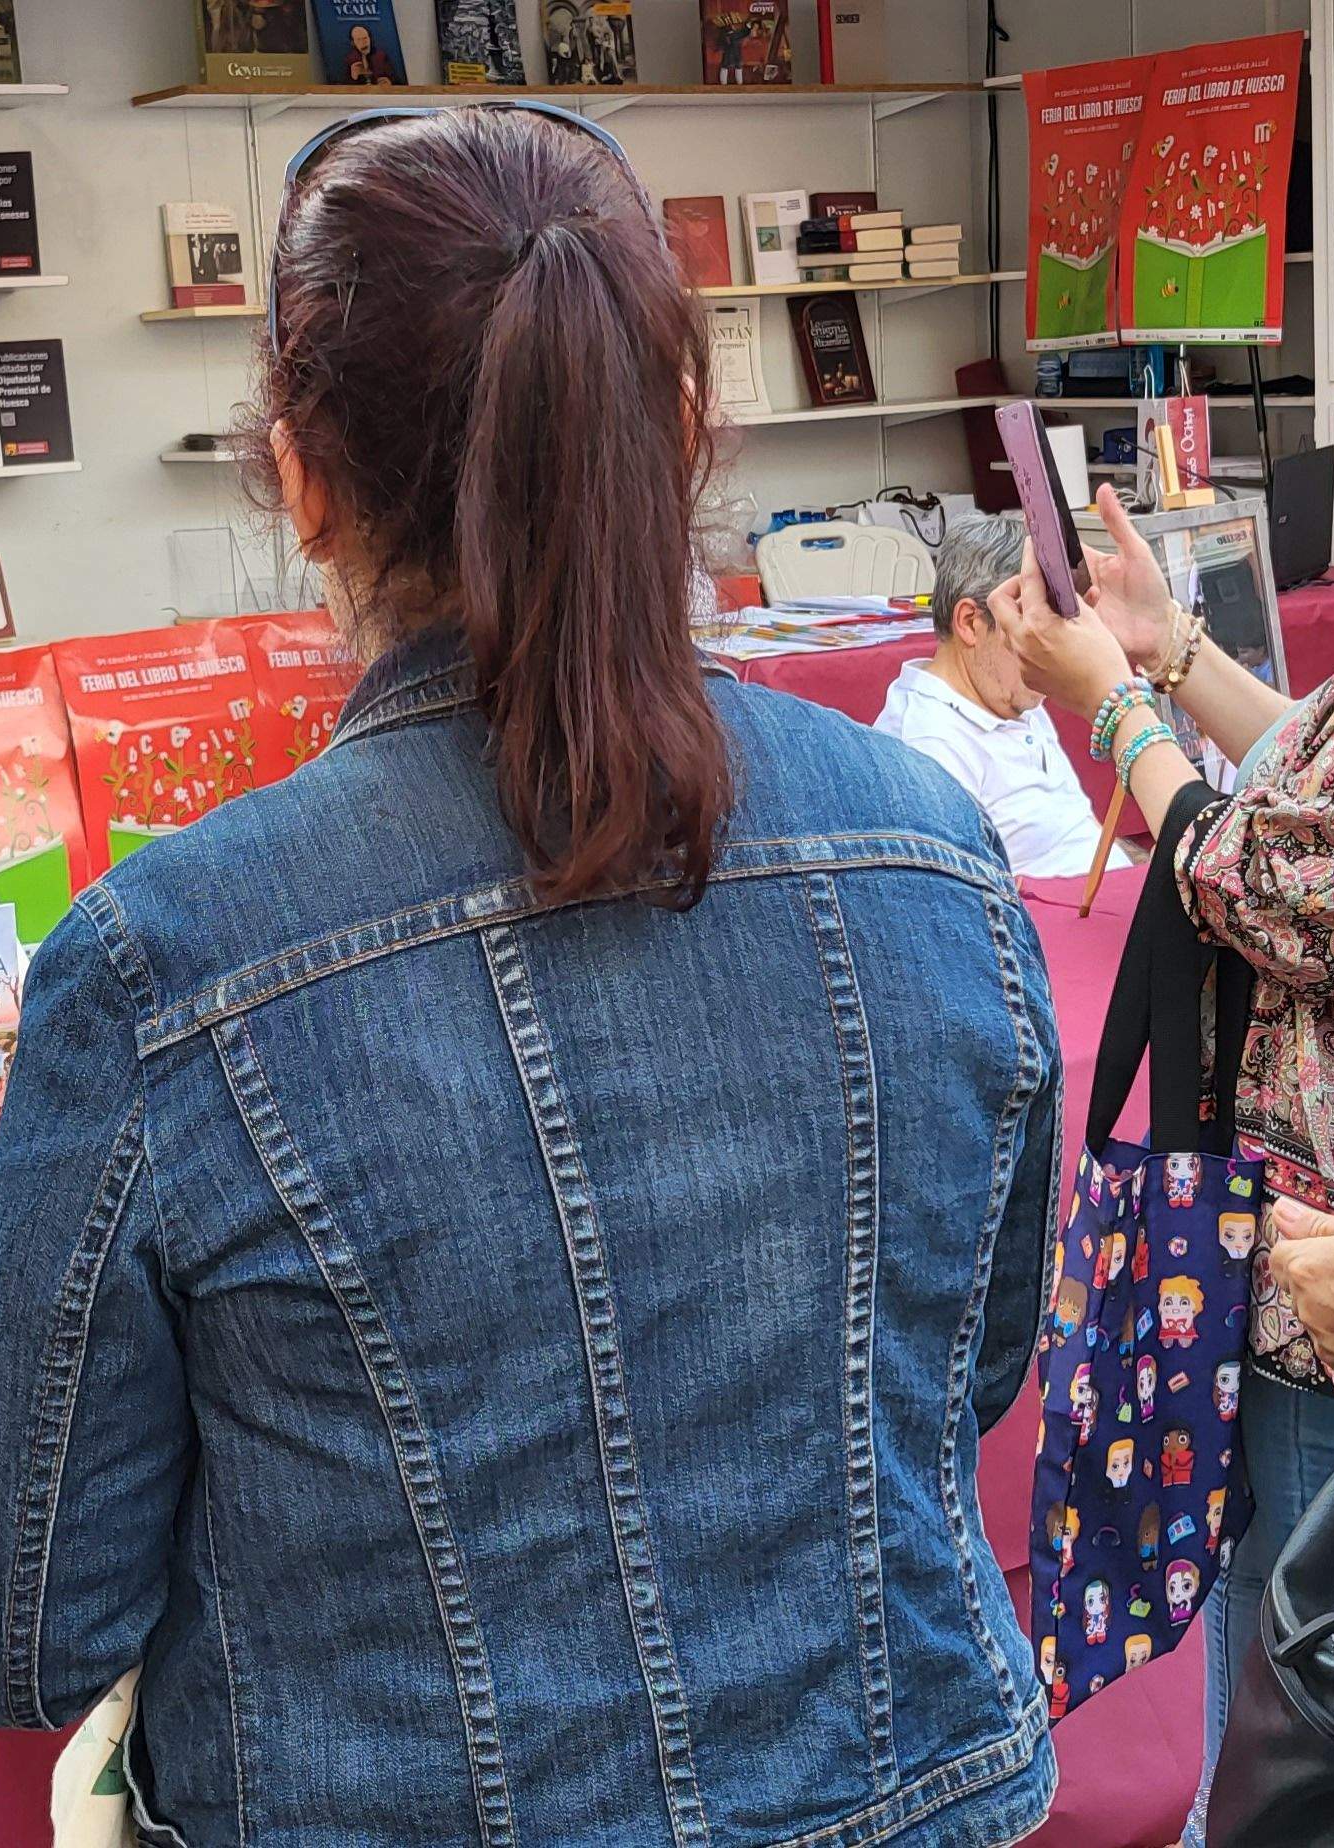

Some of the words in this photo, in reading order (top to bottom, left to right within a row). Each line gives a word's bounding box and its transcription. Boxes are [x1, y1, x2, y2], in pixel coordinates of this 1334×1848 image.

[749, 3, 774, 15] Goya
[228, 62, 261, 80] Goya
[1162, 87, 1187, 106] FERIA
[1188, 84, 1202, 103] DEL
[1203, 80, 1229, 100] LIBRO
[1232, 79, 1245, 96] DE
[1247, 74, 1285, 95] HUESCA
[1042, 106, 1062, 124] FERIA
[1064, 105, 1078, 121] DEL
[1079, 101, 1102, 119] LIBRO
[1103, 100, 1115, 116] DE
[31, 365, 44, 375] por
[41, 386, 51, 395] de
[0, 398, 29, 408] Huesca
[268, 650, 302, 668] FERIA
[79, 673, 116, 693] FERIA
[116, 670, 141, 689] DEL
[140, 666, 178, 685] LIBRO
[179, 662, 197, 680] DE
[198, 655, 247, 677] HUESCA
